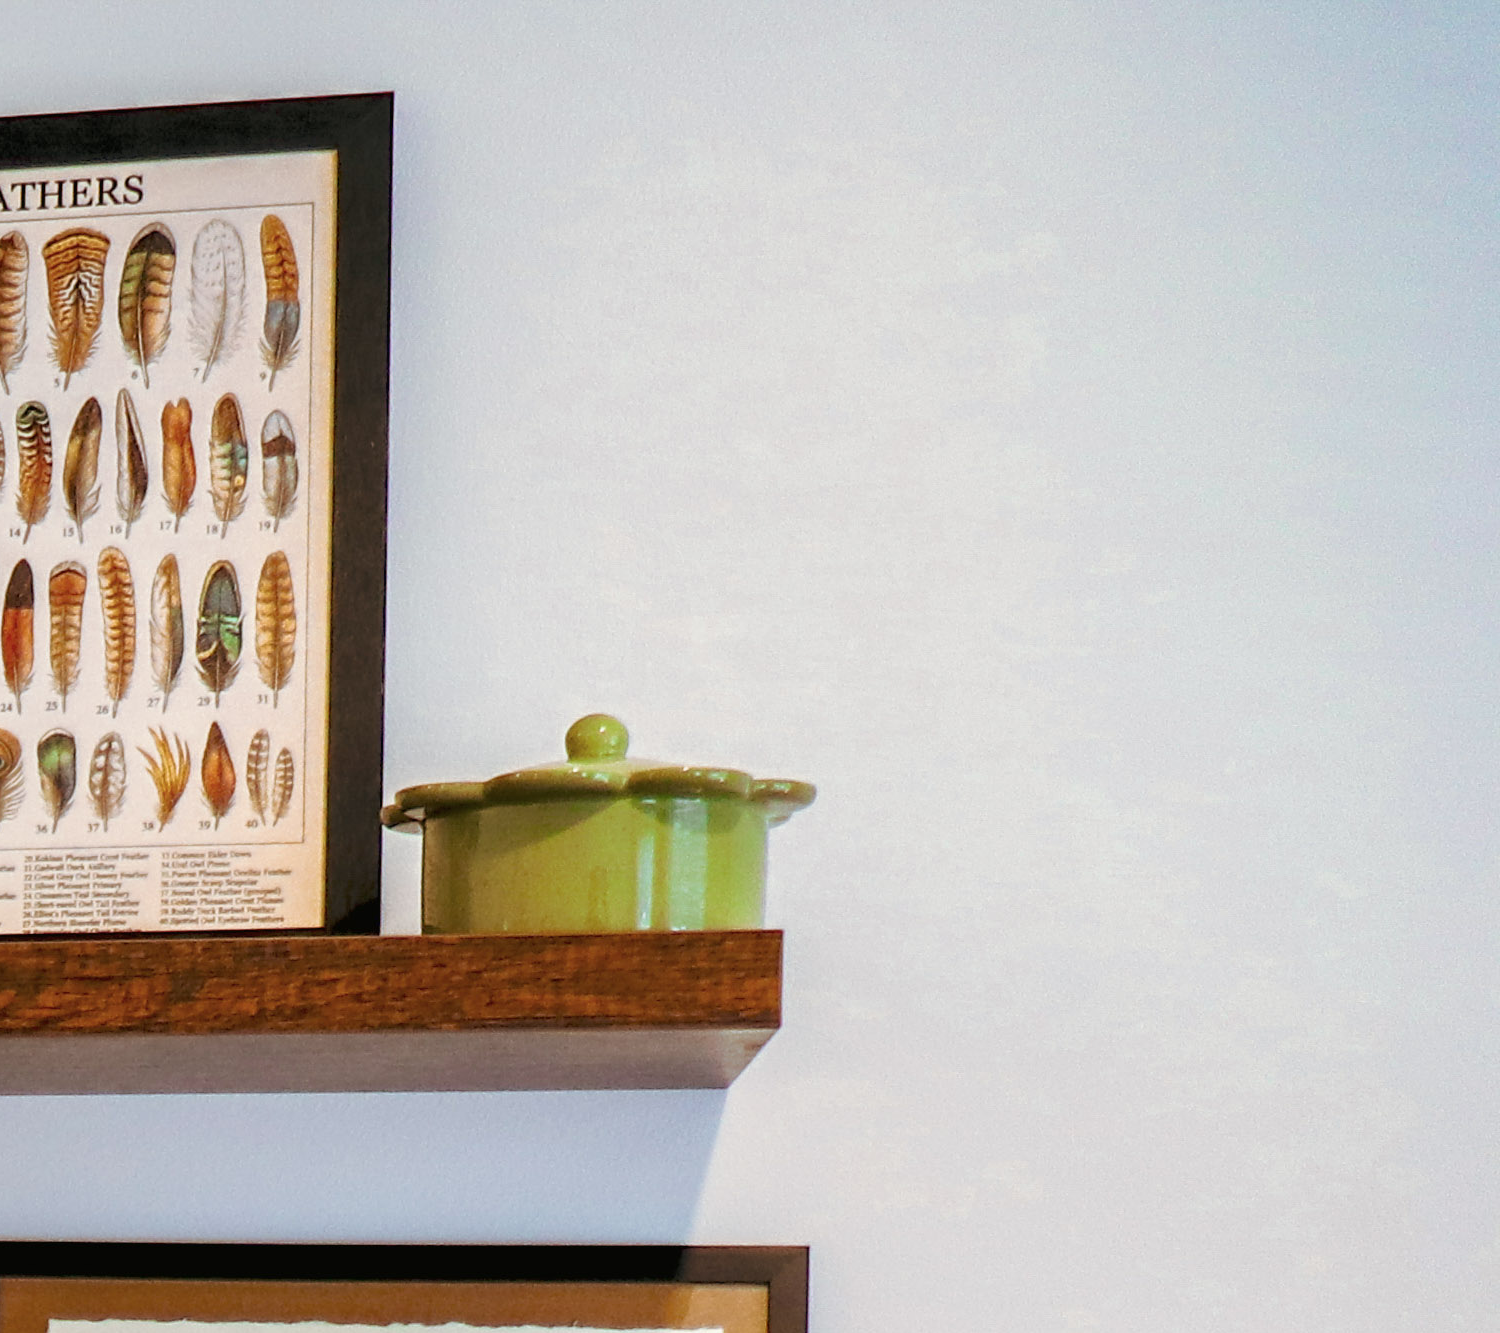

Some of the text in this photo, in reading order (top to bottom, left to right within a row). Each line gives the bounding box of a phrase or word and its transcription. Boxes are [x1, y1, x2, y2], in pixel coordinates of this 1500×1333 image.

[109, 525, 122, 534] 16
[159, 521, 172, 531] 17
[206, 525, 219, 534] 18
[258, 522, 271, 531] 19
[9, 528, 21, 537] 14
[63, 528, 74, 537] 15
[45, 702, 58, 711] 25
[147, 698, 160, 707] 27
[0, 703, 13, 712] 24
[36, 824, 48, 834] 36
[87, 823, 100, 832] 37
[198, 820, 211, 830] 39
